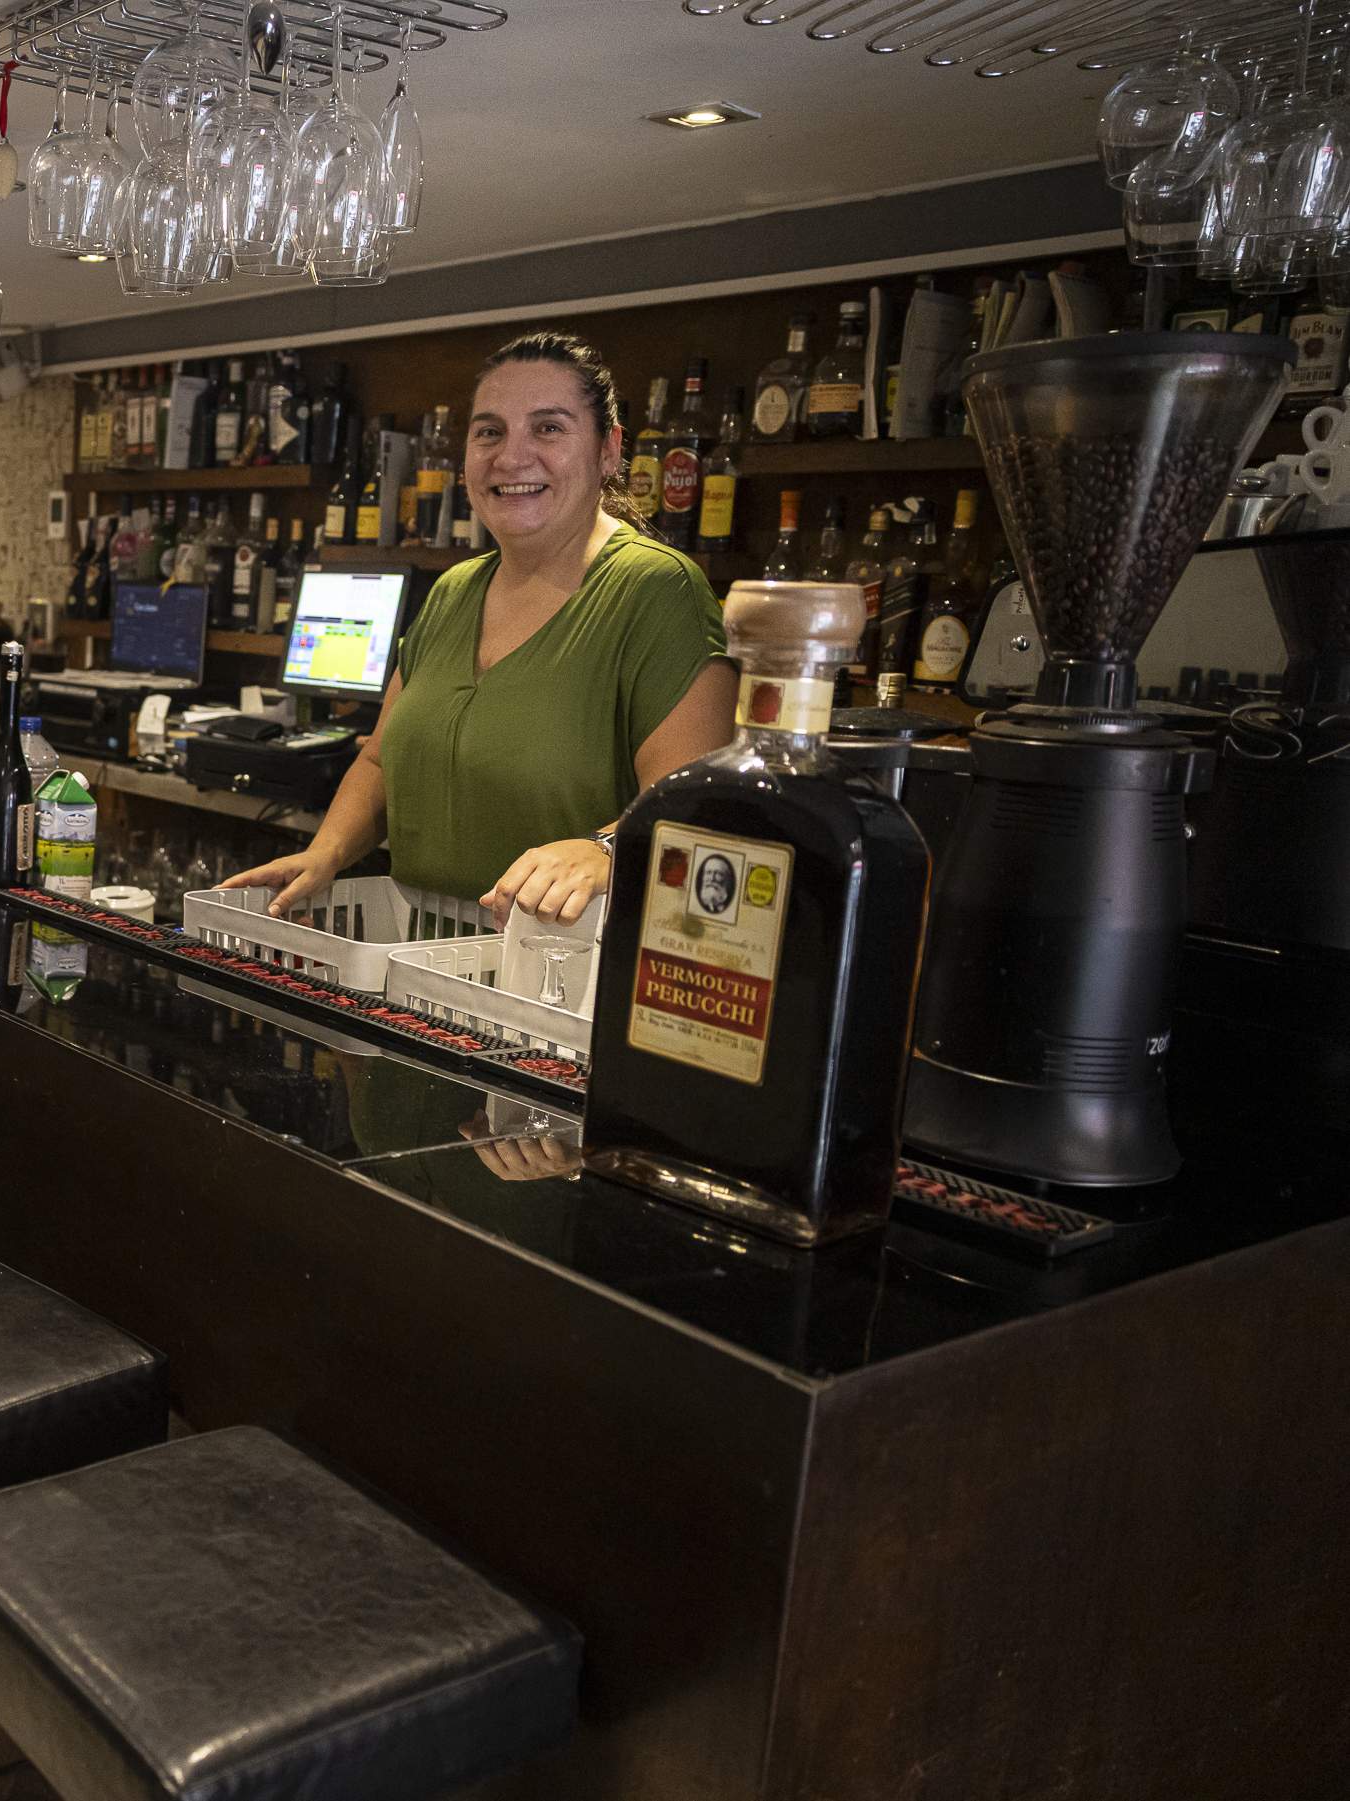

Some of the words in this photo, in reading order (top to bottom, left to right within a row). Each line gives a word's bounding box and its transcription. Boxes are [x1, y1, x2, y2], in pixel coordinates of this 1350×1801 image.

[664, 473, 697, 490] Pujol
[649, 959, 758, 1001] VERMOUTH
[646, 981, 756, 1026] PERUCCHI
